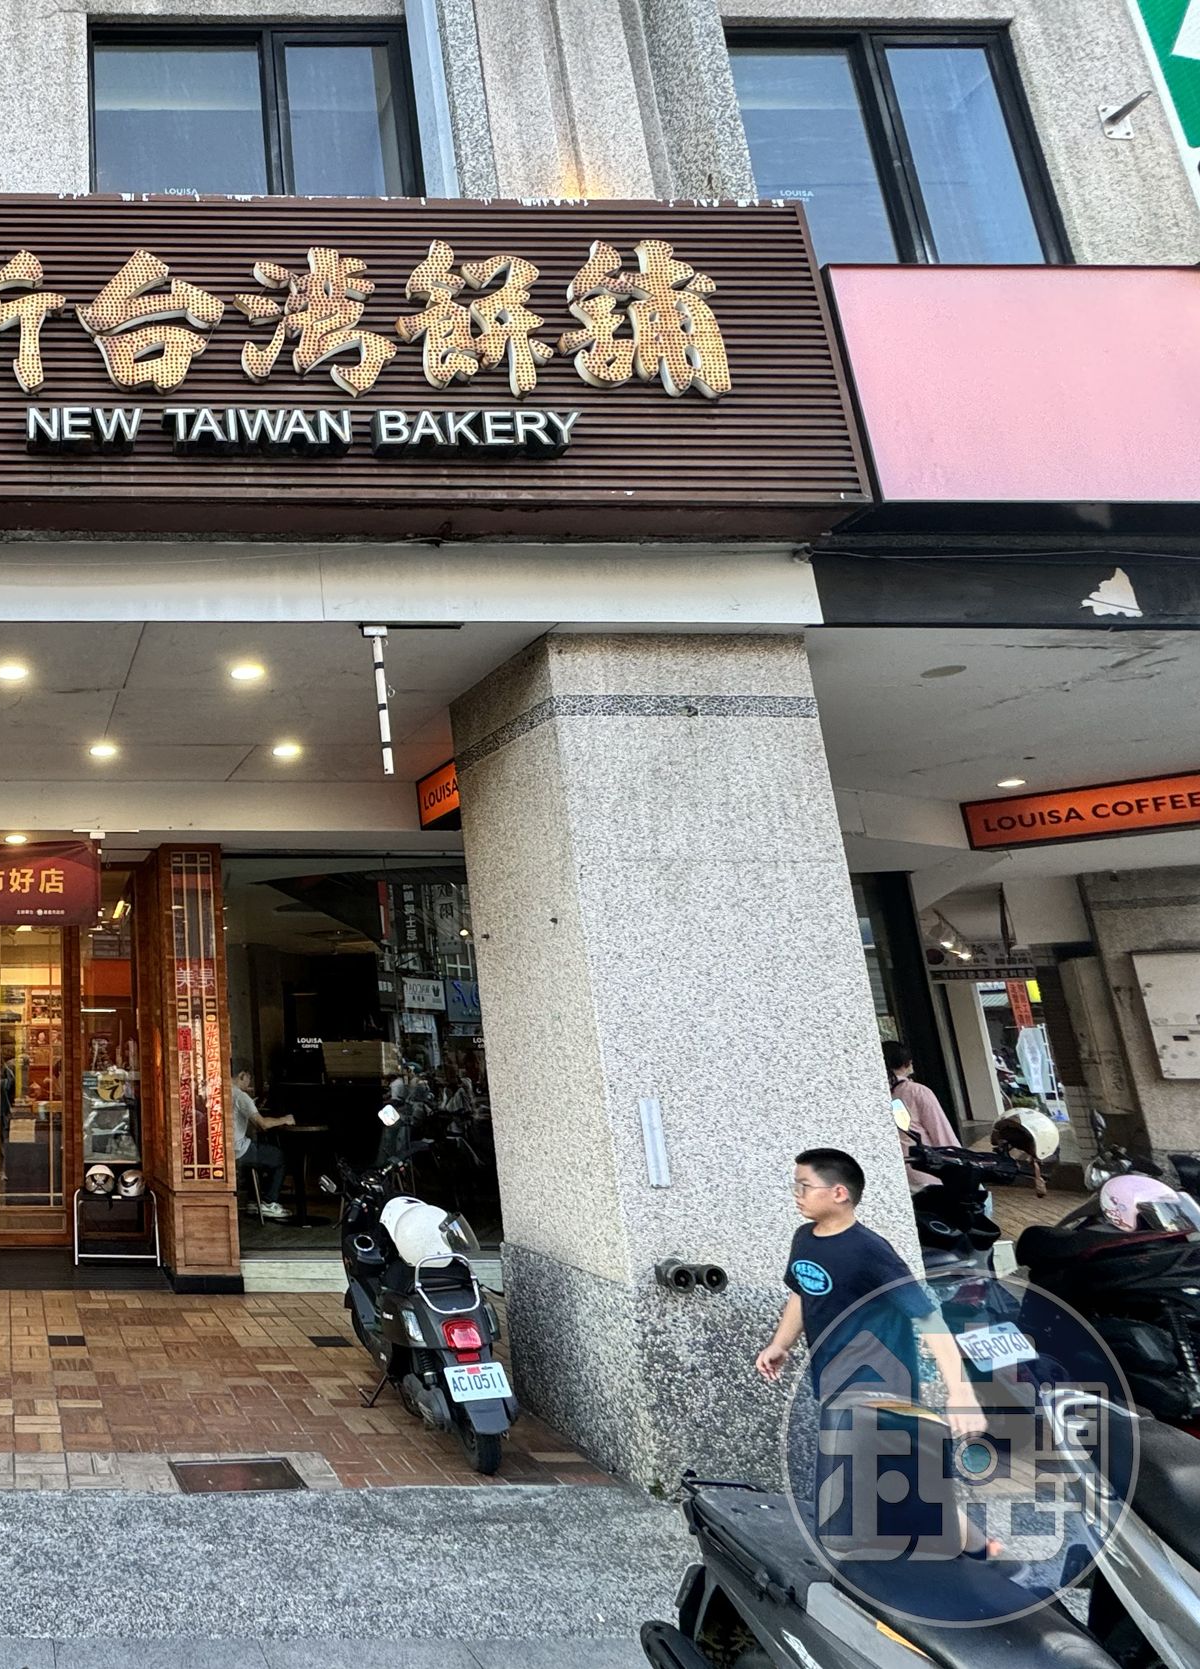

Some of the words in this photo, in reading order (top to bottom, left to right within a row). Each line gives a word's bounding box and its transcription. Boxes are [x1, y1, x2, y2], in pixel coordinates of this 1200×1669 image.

[780, 189, 814, 198] LOUISA
[27, 407, 142, 442] NEW
[169, 409, 353, 443] TAIWAN
[377, 410, 583, 446] BAKERY
[423, 778, 460, 811] LOUISA
[983, 806, 1085, 833] LOUISA
[1091, 791, 1200, 819] COFFEE
